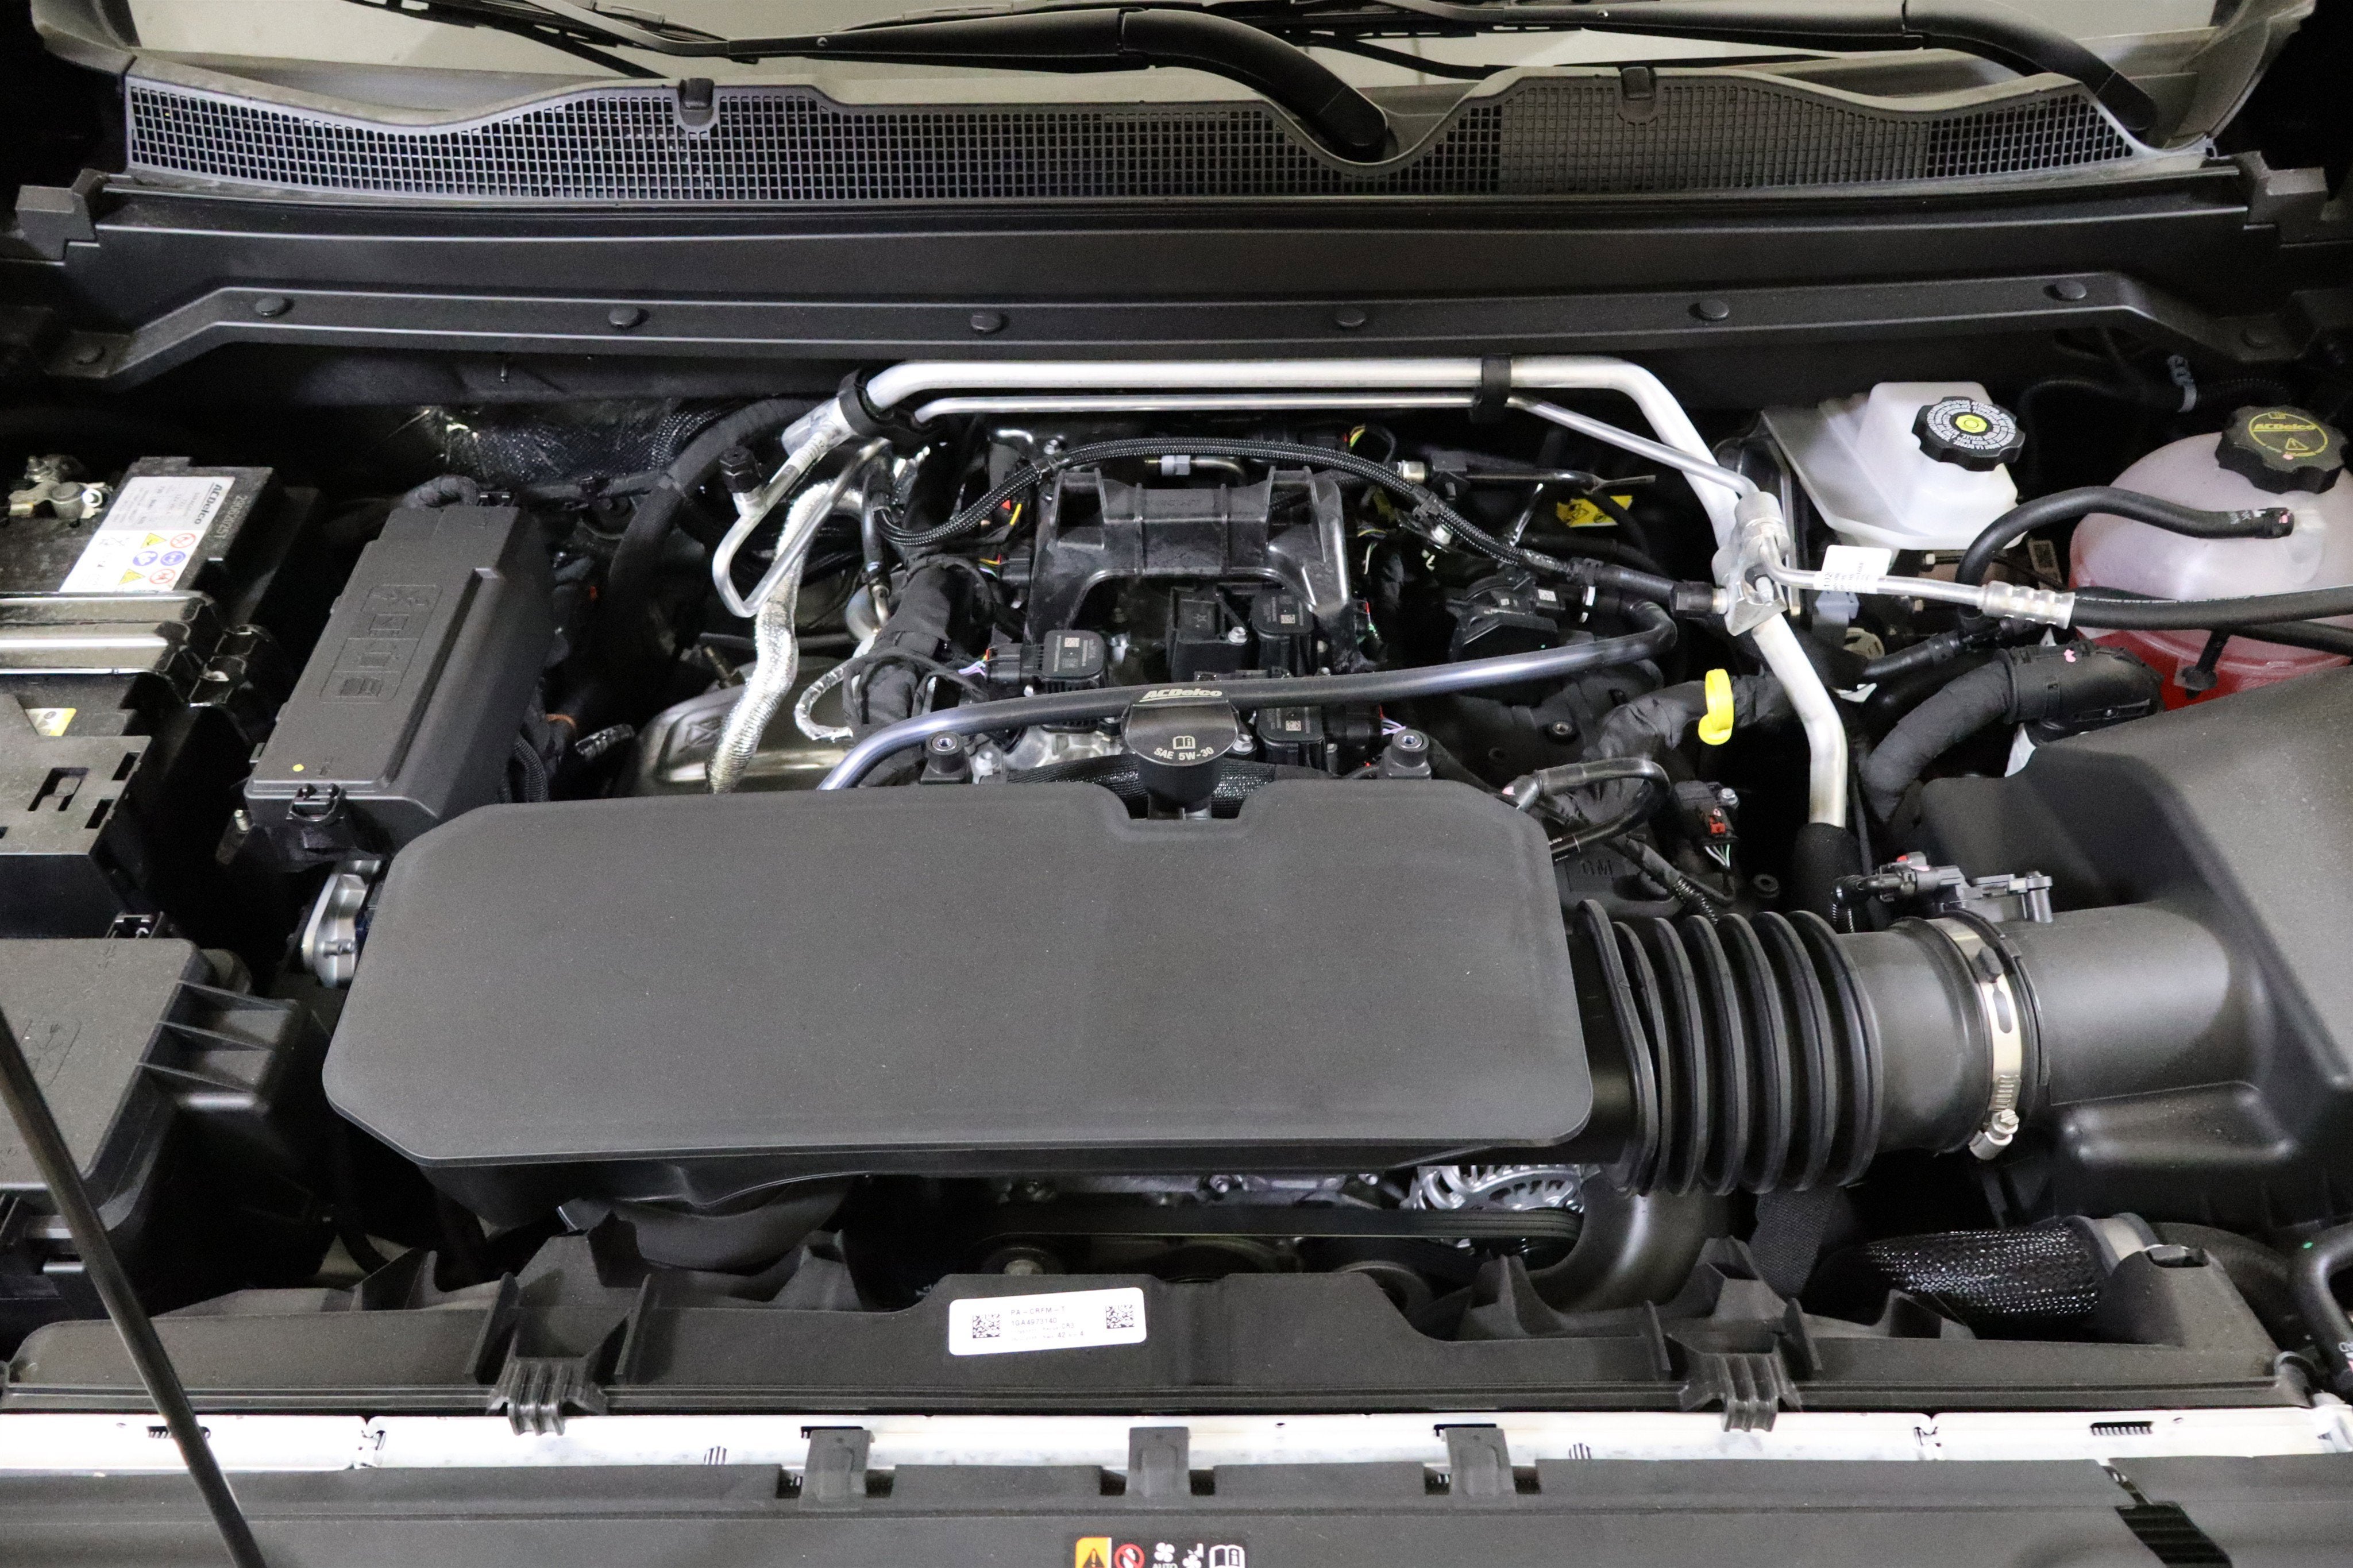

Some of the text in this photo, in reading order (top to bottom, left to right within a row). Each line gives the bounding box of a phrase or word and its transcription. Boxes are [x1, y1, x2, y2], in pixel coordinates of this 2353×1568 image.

[194, 484, 222, 524] ACDelco
[1141, 688, 1223, 699] ACDelco
[1154, 747, 1214, 760] SAE 5W-30
